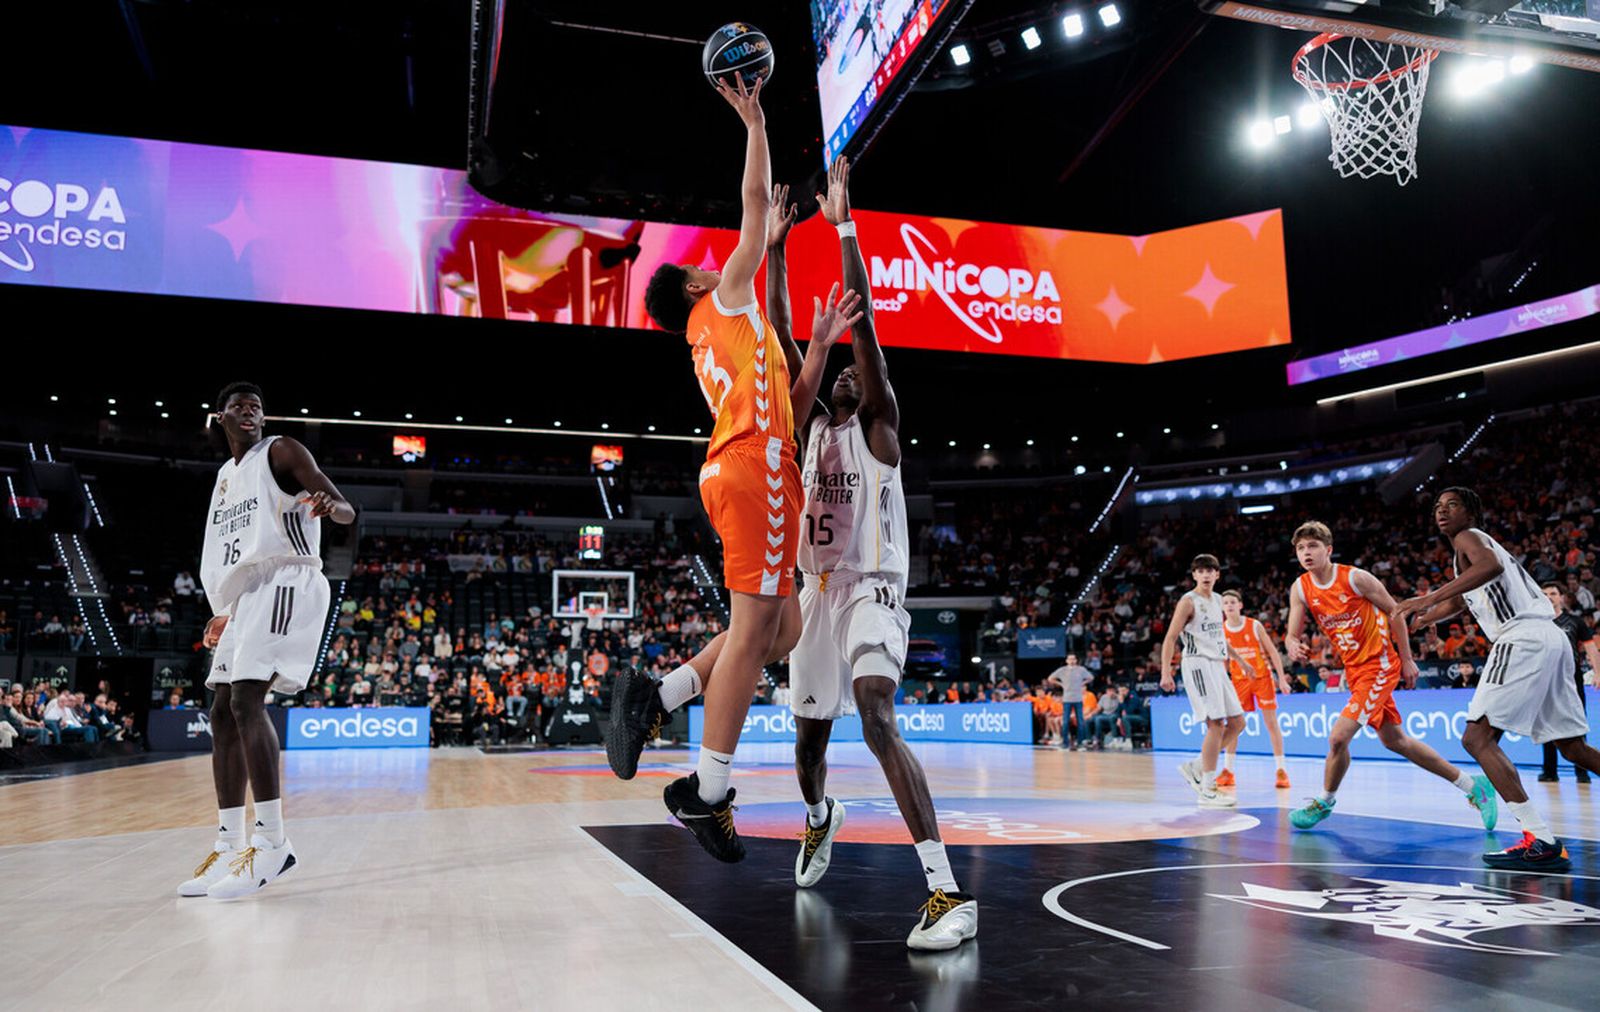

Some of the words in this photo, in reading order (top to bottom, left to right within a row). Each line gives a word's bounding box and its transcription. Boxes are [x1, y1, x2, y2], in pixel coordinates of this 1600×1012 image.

[1233, 7, 1315, 28] MINICOPA
[723, 41, 769, 63] Wilson
[967, 299, 1063, 325] endesa
[816, 487, 853, 504] BETTER
[213, 497, 258, 525] Emirates
[230, 514, 251, 534] BETTER
[806, 513, 833, 546] 15
[223, 538, 241, 566] 16
[301, 713, 418, 738] endesa
[896, 709, 945, 731] ndesa
[962, 708, 1010, 732] endesa
